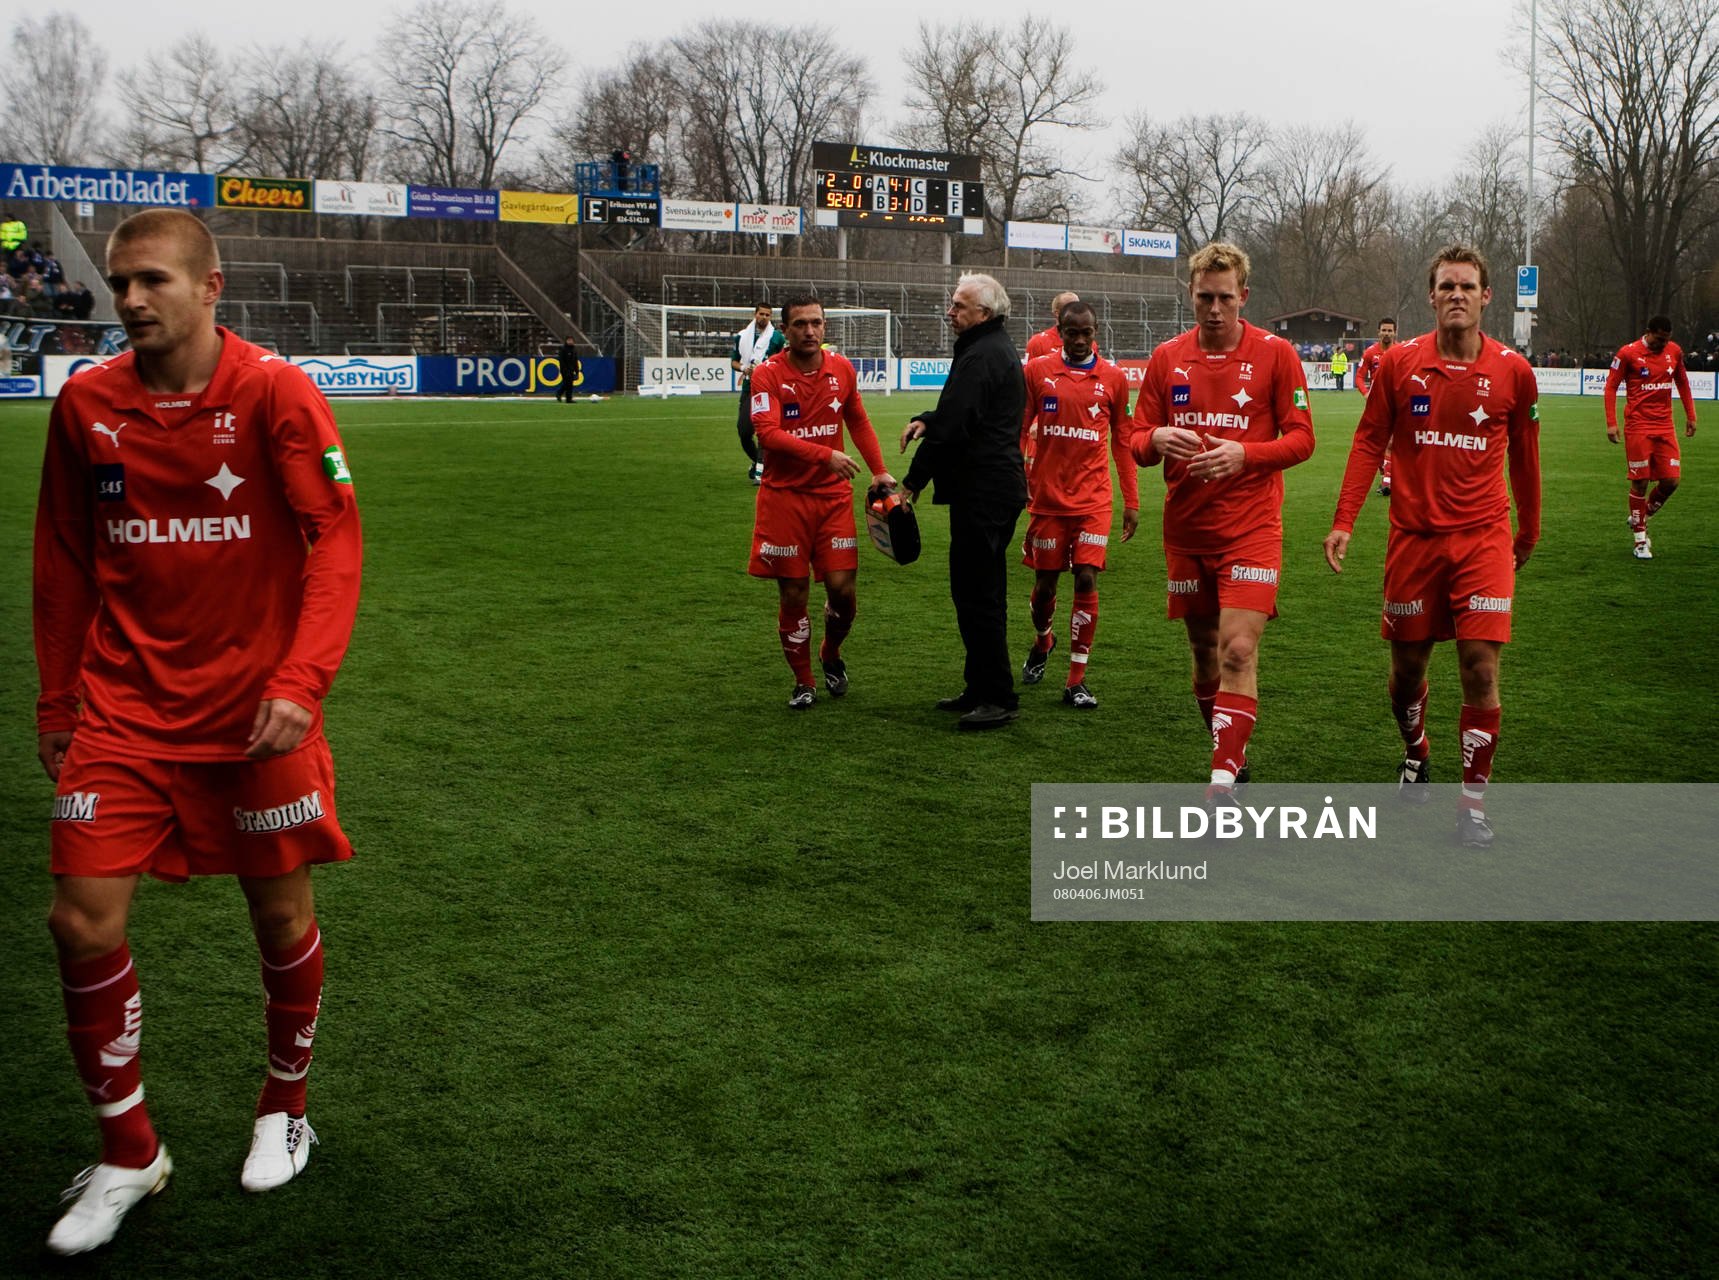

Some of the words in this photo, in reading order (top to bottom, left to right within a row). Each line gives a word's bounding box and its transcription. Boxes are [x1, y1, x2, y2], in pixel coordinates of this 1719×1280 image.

[869, 151, 950, 171] Klockmaster
[221, 178, 305, 208] Cheers
[827, 193, 861, 208] 92:01
[589, 200, 603, 221] E
[665, 206, 697, 215] Svenska
[697, 207, 723, 219] kyrkan
[1129, 236, 1172, 250] SKANSKA
[308, 371, 408, 386] LVSBYHUS
[155, 400, 192, 408] HOLMEN
[1174, 393, 1189, 402] SAS
[1413, 404, 1430, 413] SAS
[1173, 412, 1249, 429] HOLMEN
[1043, 425, 1100, 441] HOLMEN
[1415, 430, 1487, 451] HOLMEN
[99, 480, 123, 494] SAS
[107, 514, 251, 543] HOLMEN
[760, 541, 799, 557] STADIUM
[232, 790, 323, 830] STADIUM
